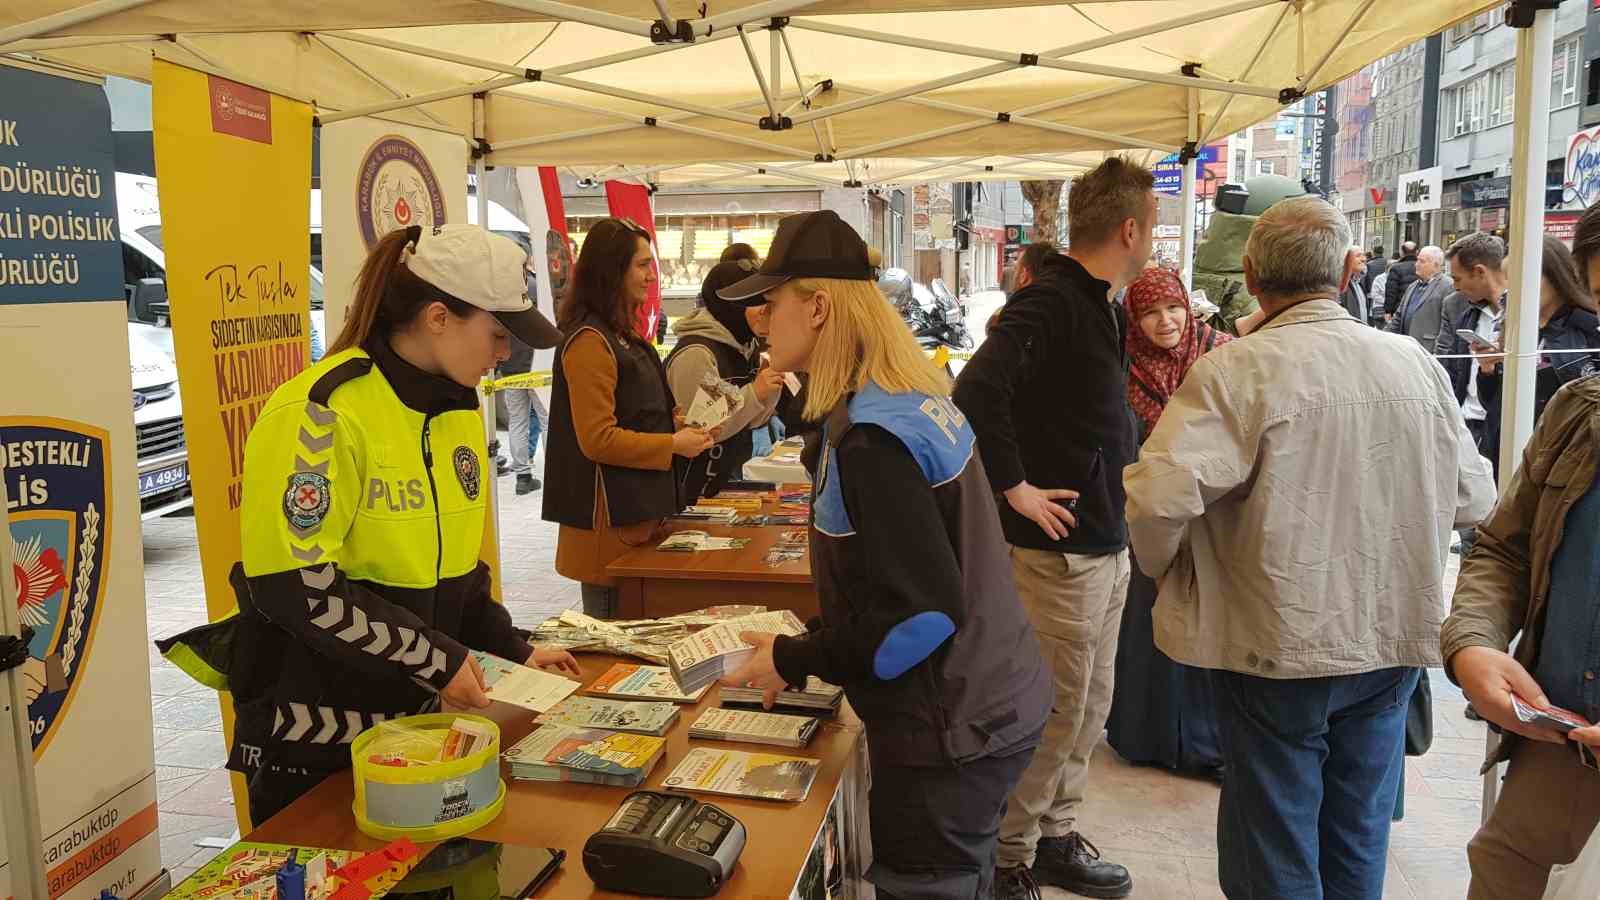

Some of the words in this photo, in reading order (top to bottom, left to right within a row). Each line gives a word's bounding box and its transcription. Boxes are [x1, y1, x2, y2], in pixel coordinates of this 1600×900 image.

[28, 210, 116, 241] POLİSLİK
[156, 466, 183, 485] 4934
[48, 836, 121, 895] arabuktdp
